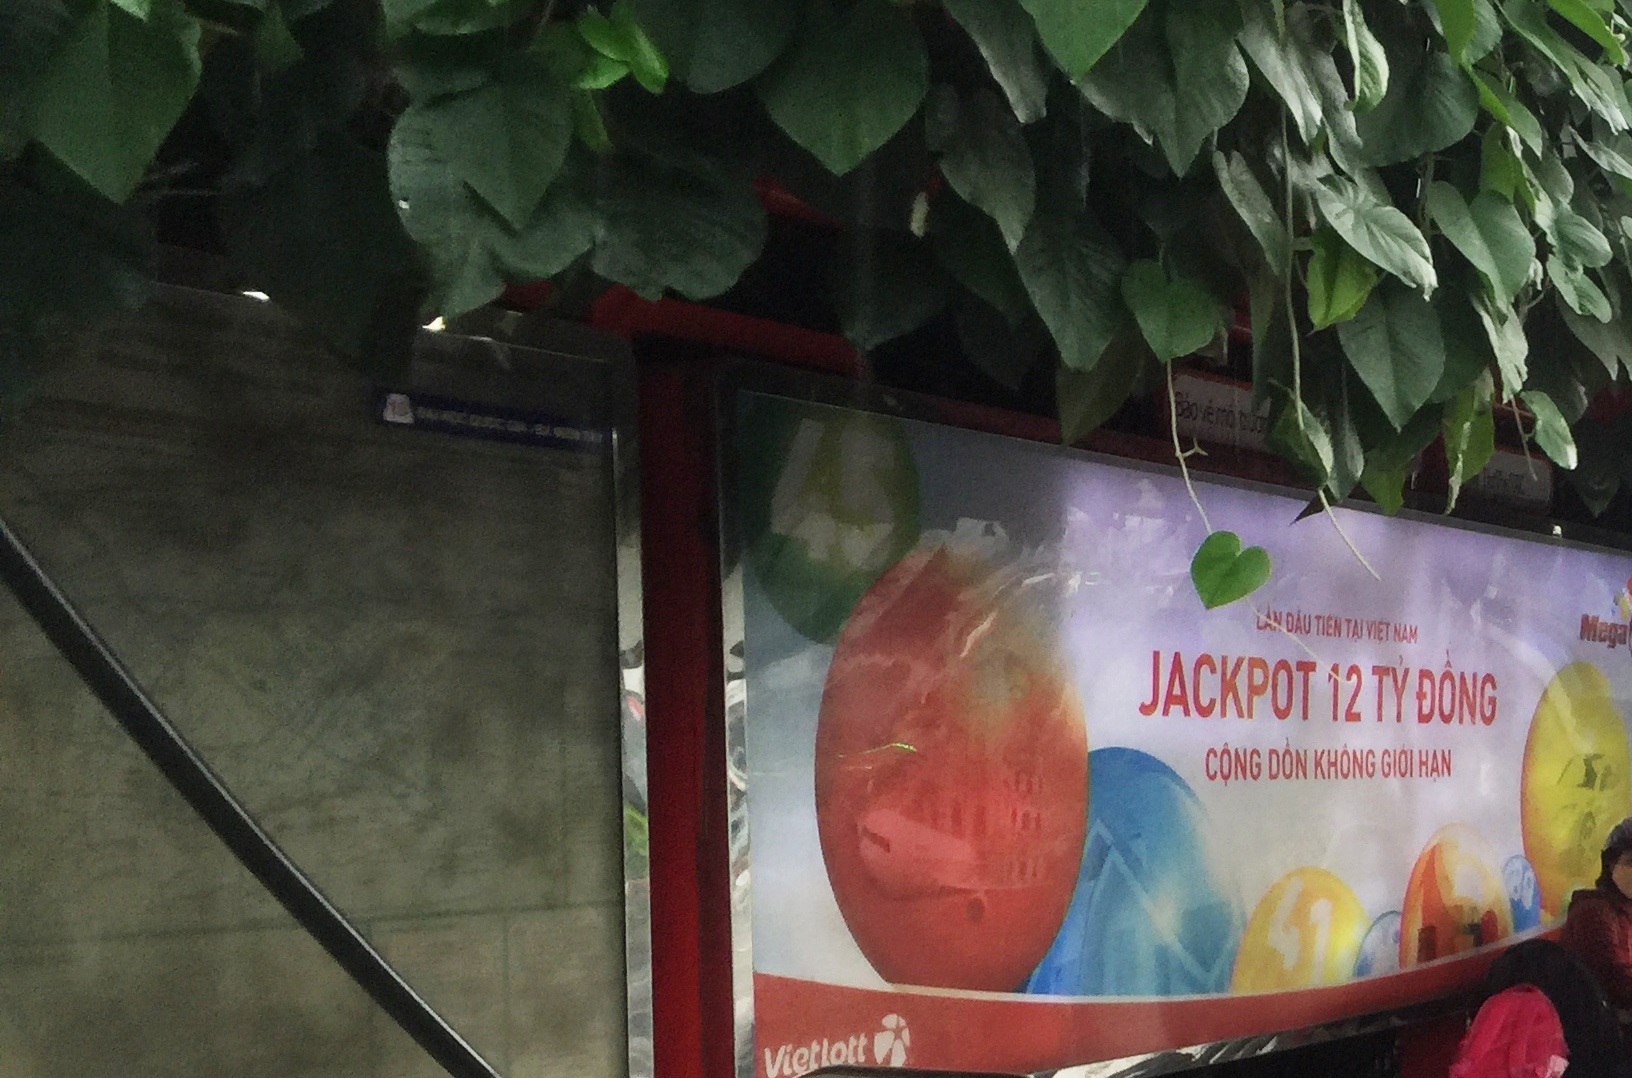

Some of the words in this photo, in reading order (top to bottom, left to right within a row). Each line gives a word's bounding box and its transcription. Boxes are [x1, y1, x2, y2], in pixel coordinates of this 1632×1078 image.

[1315, 613, 1343, 638] TIÊN
[1366, 616, 1392, 645] VIỆT
[1393, 622, 1419, 645] NAM
[1580, 613, 1628, 649] Mega
[1138, 649, 1318, 722] JACKPOT
[1327, 662, 1363, 723] 12
[1371, 654, 1411, 724] TỶ
[1415, 648, 1498, 727] ĐỒNG
[1204, 741, 1263, 787] CỘNG
[1268, 737, 1308, 781] DỒN
[1313, 743, 1377, 781] KHÔNG
[1418, 748, 1453, 784] HẠN
